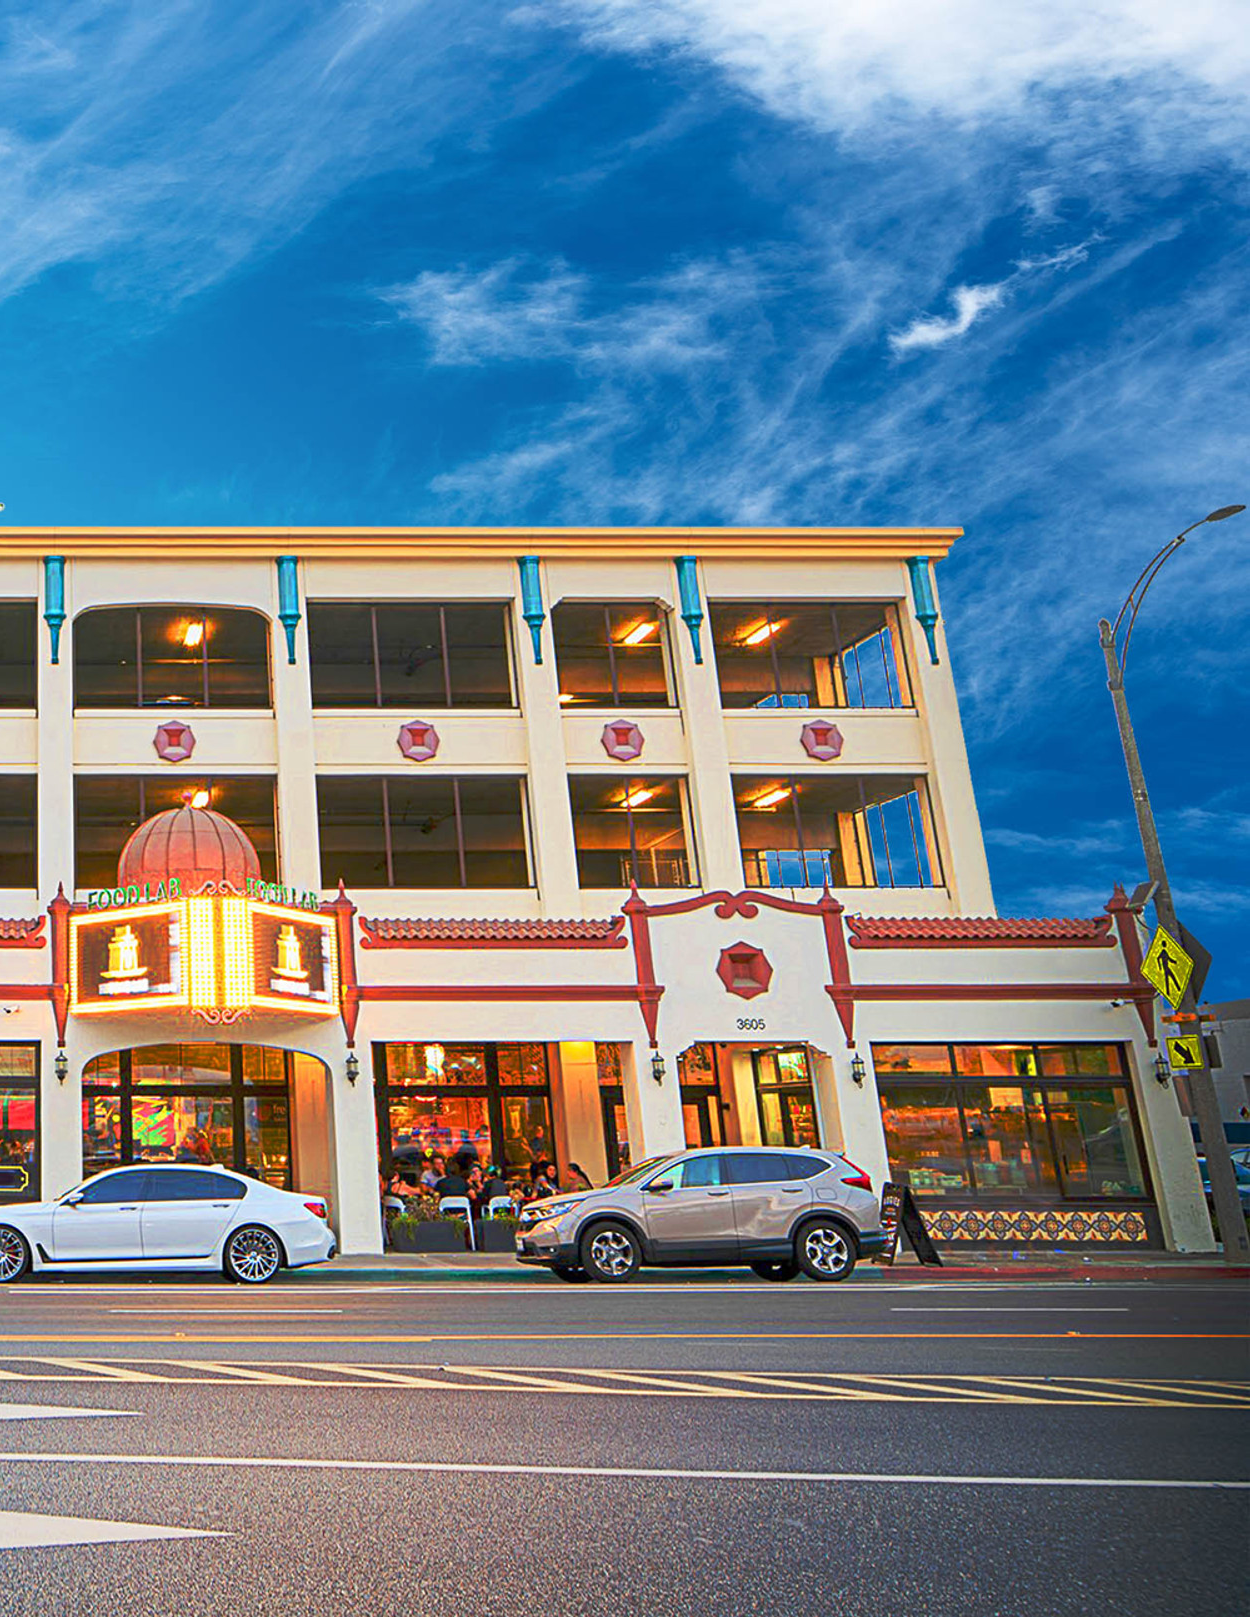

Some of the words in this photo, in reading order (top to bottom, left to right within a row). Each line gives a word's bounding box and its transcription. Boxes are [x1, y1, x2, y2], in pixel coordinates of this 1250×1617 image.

[87, 886, 140, 910] FOOD
[144, 878, 182, 902] LAB
[736, 1018, 766, 1030] 3605
